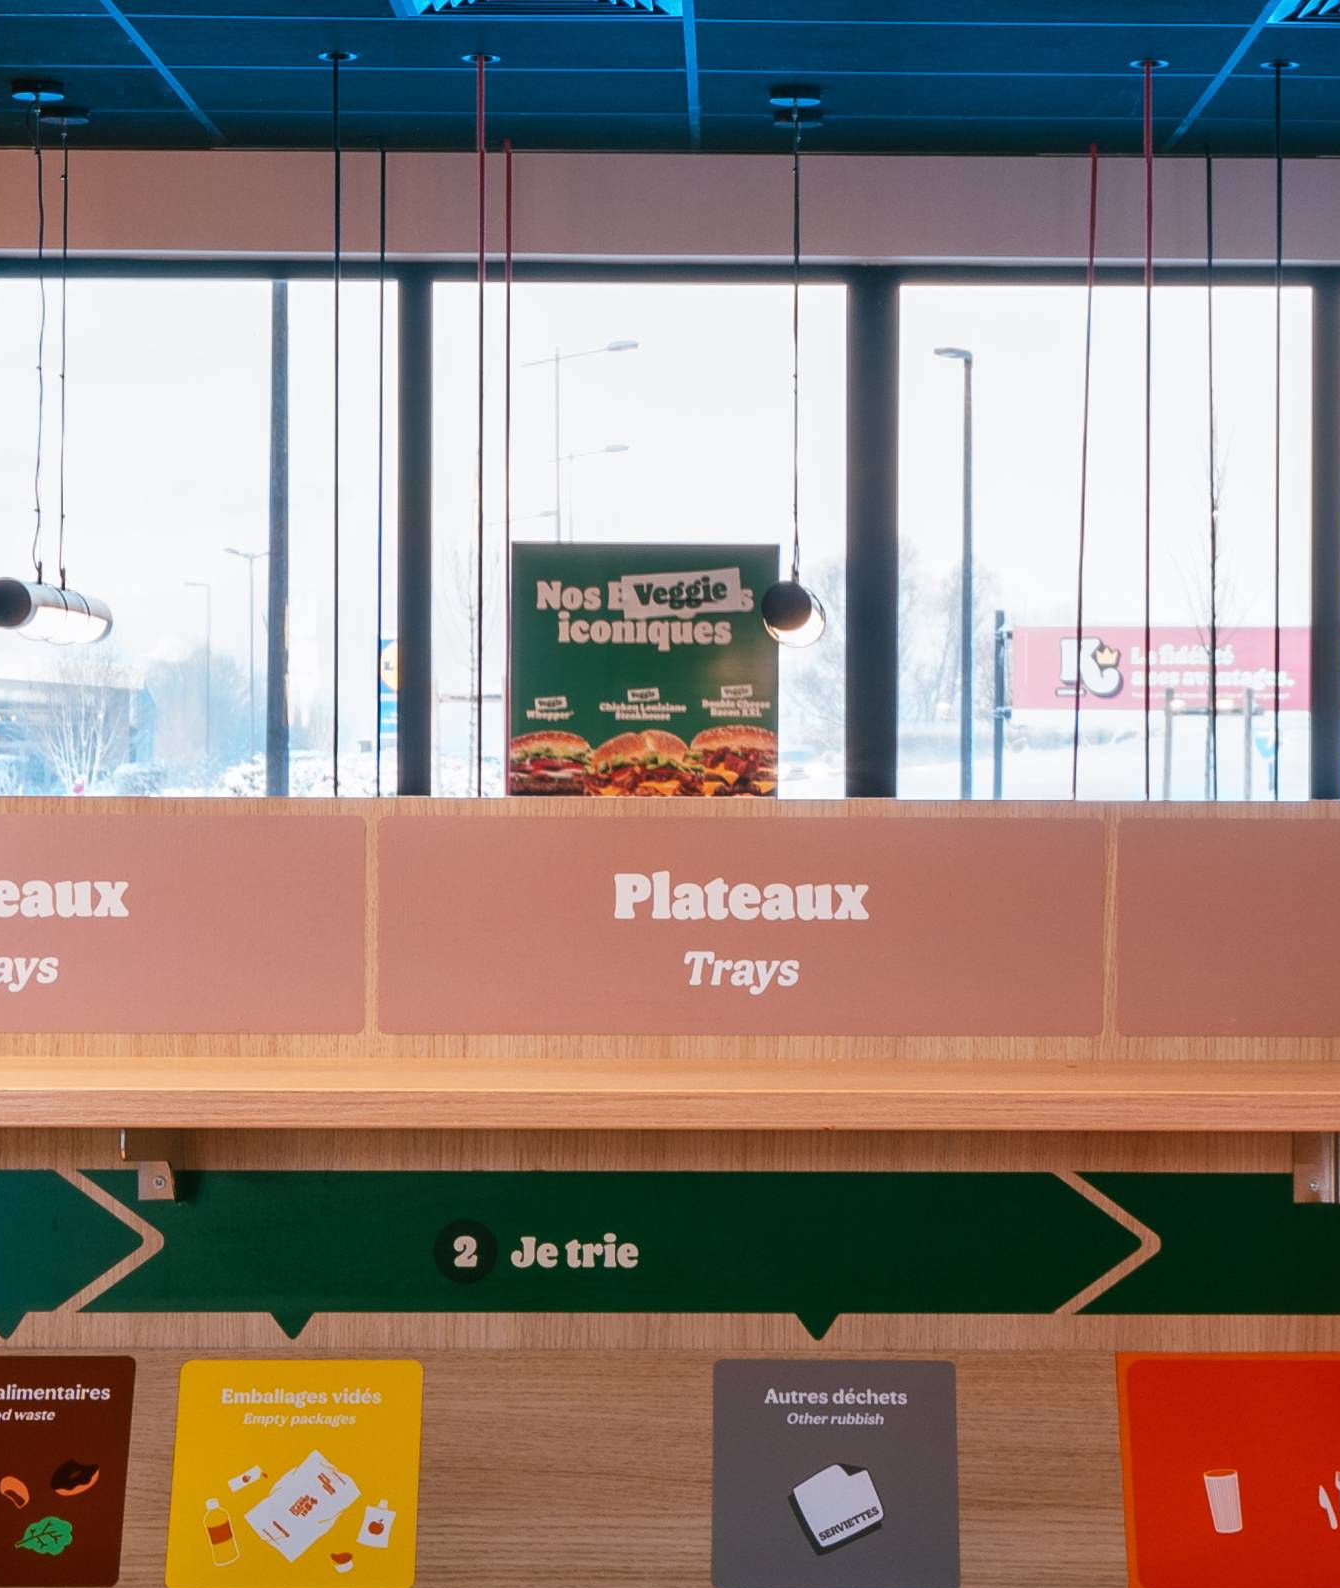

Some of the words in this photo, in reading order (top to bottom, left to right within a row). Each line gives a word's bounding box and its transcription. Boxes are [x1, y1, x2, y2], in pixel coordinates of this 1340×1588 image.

[536, 580, 601, 611] Nos
[634, 576, 727, 609] Veggie
[558, 611, 732, 651] iconiques
[614, 870, 869, 921] Plateaux
[683, 951, 800, 995] Trays
[453, 1235, 478, 1268] 2
[510, 1236, 559, 1268] Je
[564, 1232, 640, 1269] trie
[221, 1388, 328, 1408] Emballages
[764, 1388, 829, 1405] Autres
[832, 1387, 908, 1405] déchets
[14, 1410, 56, 1421] waste
[243, 1412, 288, 1428] Empty
[290, 1412, 357, 1428] packages
[786, 1412, 829, 1425] Other
[830, 1412, 885, 1426] rubbish
[818, 1506, 880, 1542] SERVIETTES
